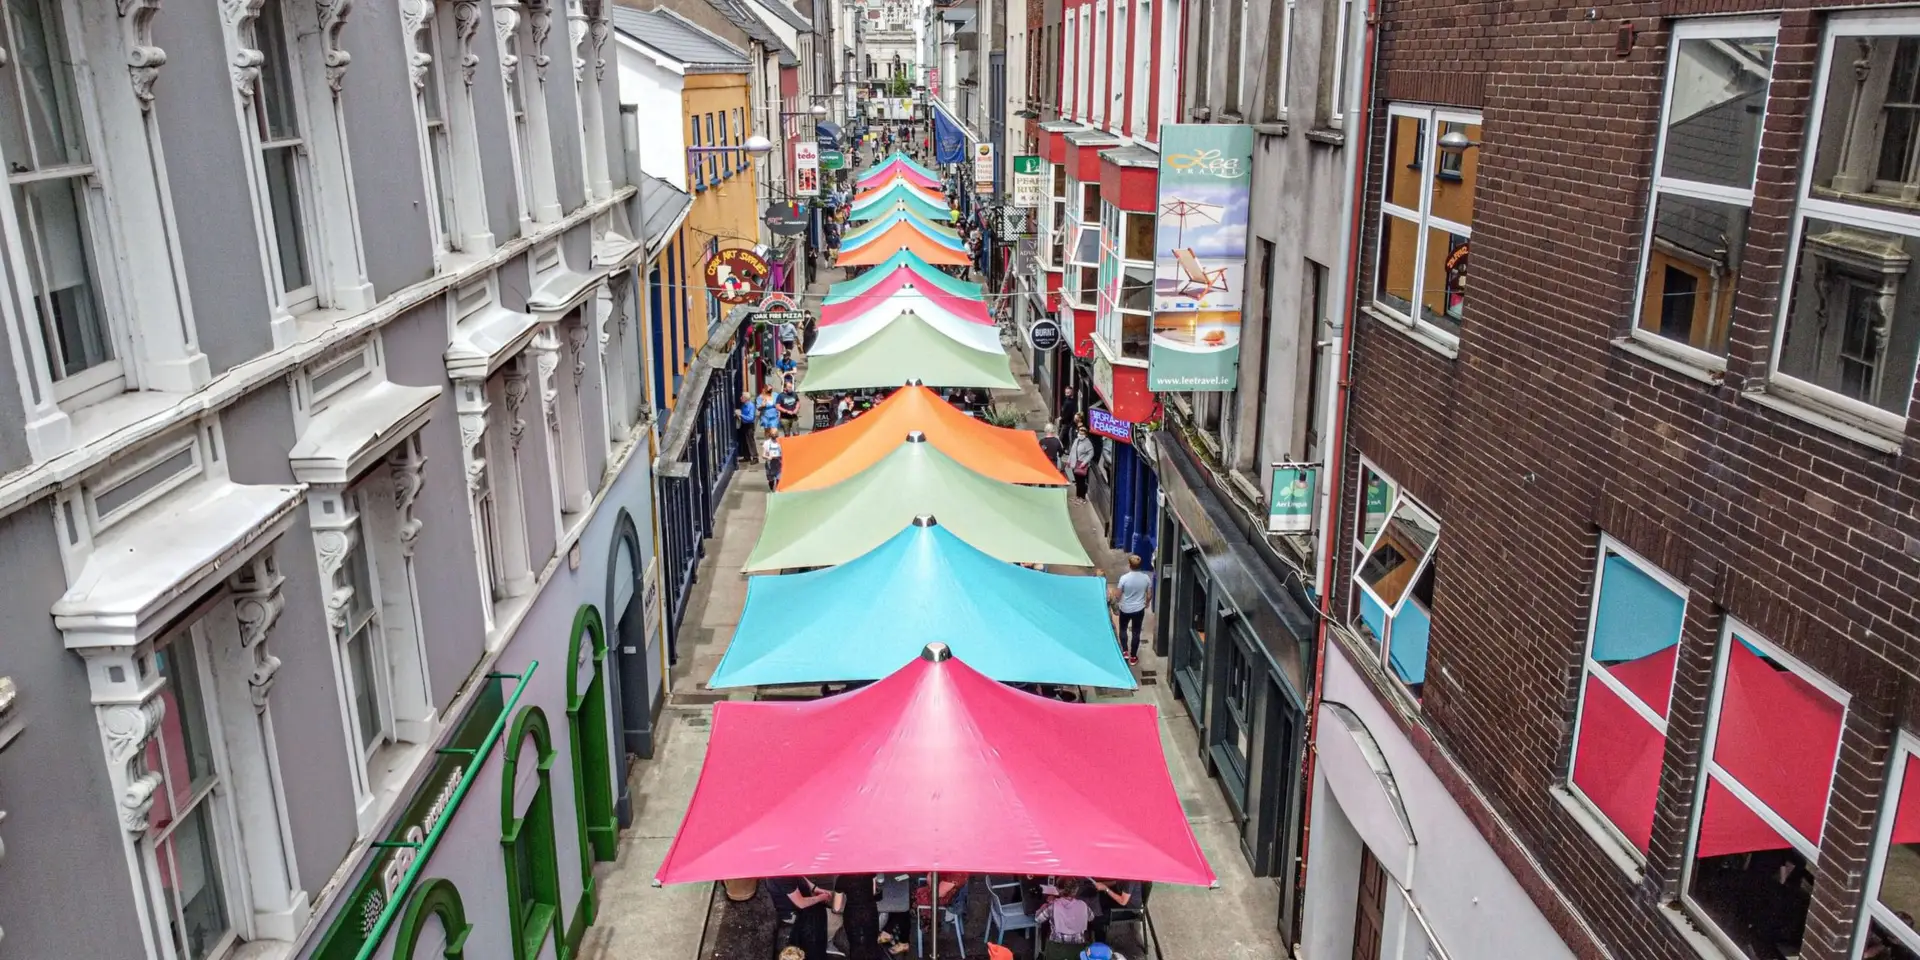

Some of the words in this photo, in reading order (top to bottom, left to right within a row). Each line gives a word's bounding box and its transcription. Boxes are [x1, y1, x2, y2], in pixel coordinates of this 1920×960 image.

[707, 255, 722, 276] CORK
[722, 250, 738, 261] ART
[740, 252, 767, 275] SUPPLIES
[1035, 328, 1055, 337] BURNT
[1157, 376, 1229, 385] www.leetravel.ie
